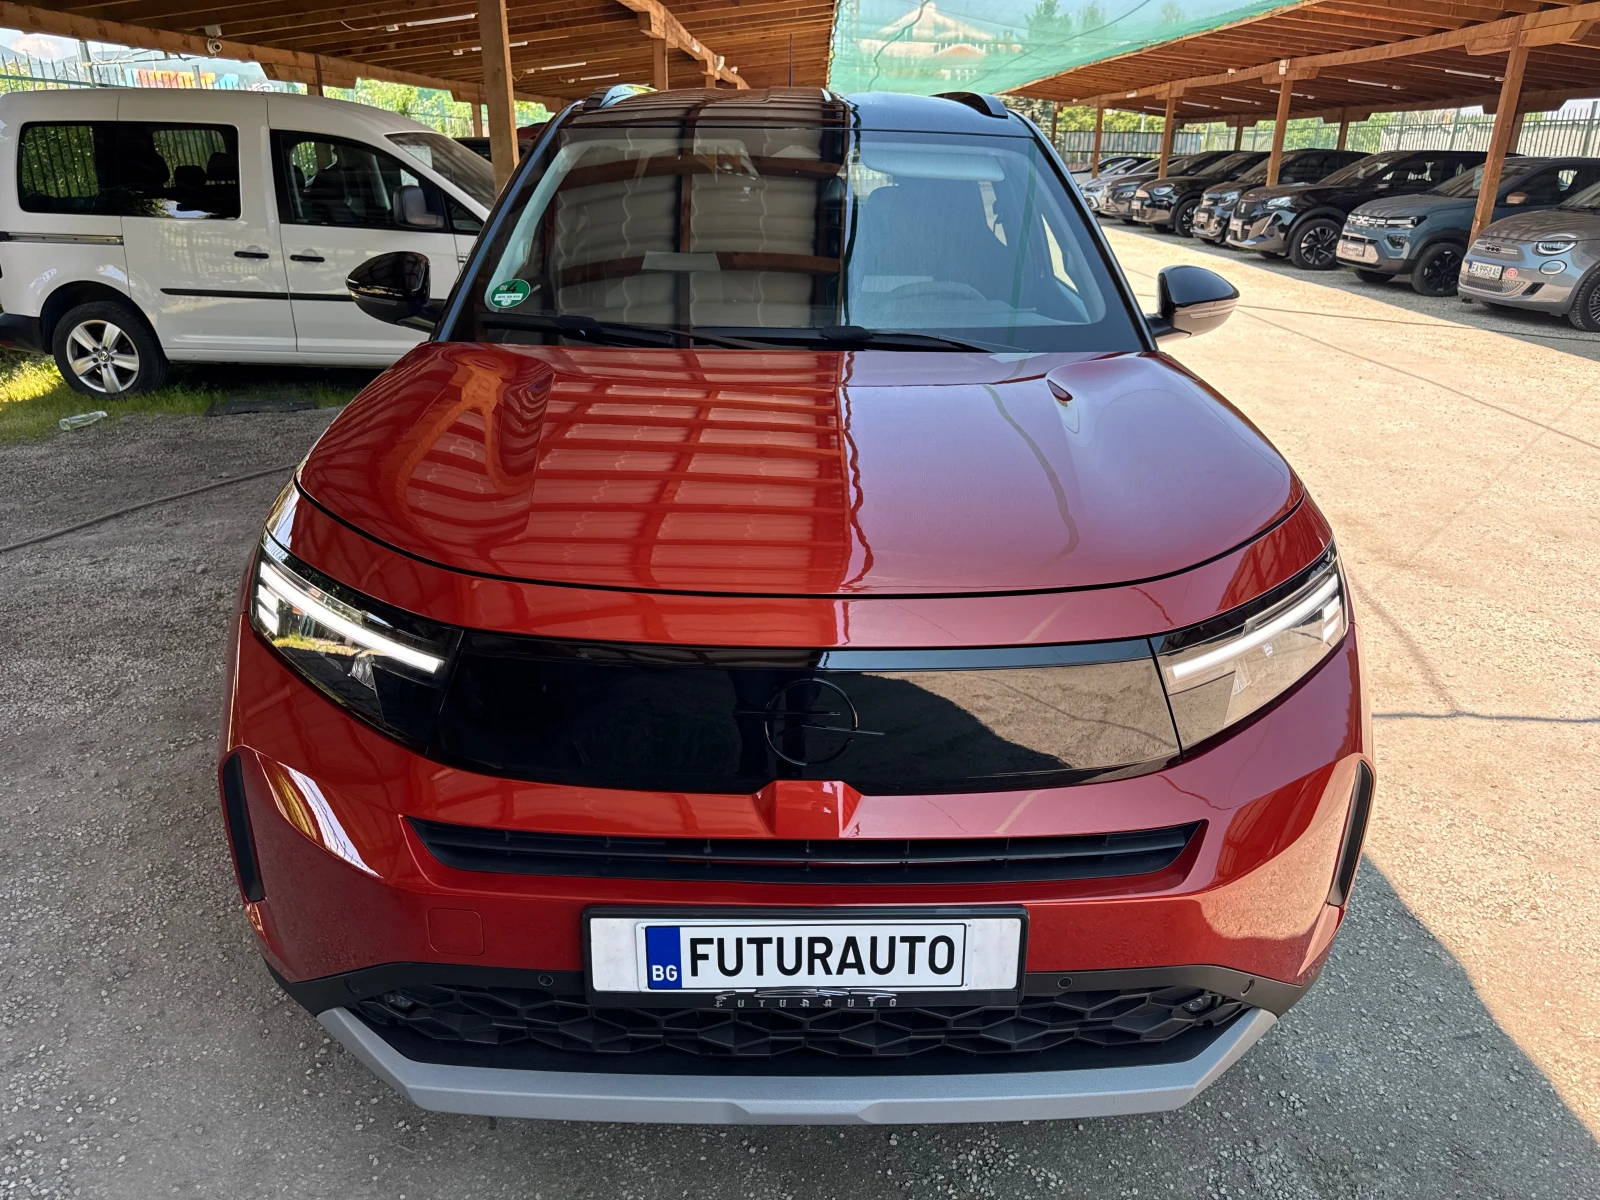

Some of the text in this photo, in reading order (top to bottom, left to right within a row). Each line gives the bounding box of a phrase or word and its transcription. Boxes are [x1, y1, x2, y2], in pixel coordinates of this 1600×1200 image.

[506, 281, 517, 293] 4
[690, 935, 955, 977] FUTURAUTO
[652, 965, 678, 981] BG
